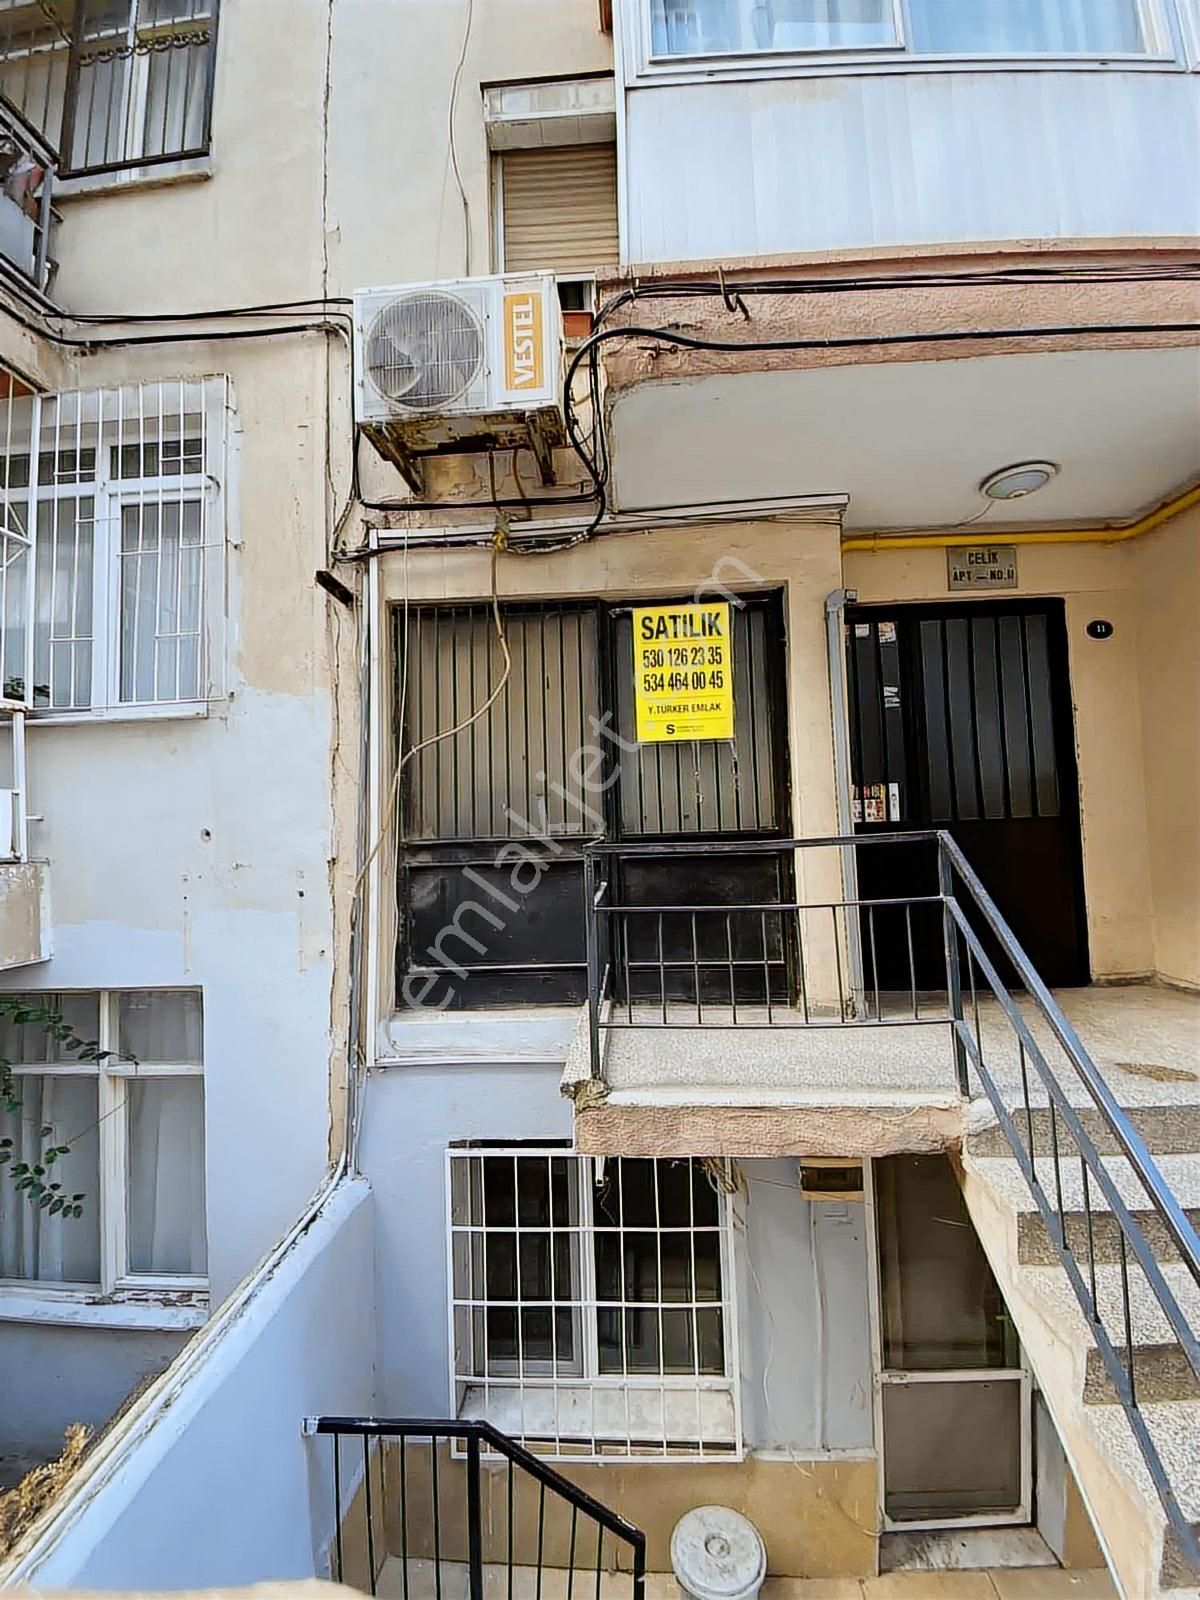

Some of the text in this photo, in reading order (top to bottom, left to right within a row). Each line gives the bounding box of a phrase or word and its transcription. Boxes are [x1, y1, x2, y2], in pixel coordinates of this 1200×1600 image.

[512, 296, 535, 386] VESTEL
[641, 612, 722, 640] SATILIK
[643, 646, 722, 668] 530 126 23 35
[644, 670, 723, 691] 534 464 00 45
[691, 703, 721, 713] EMLAK
